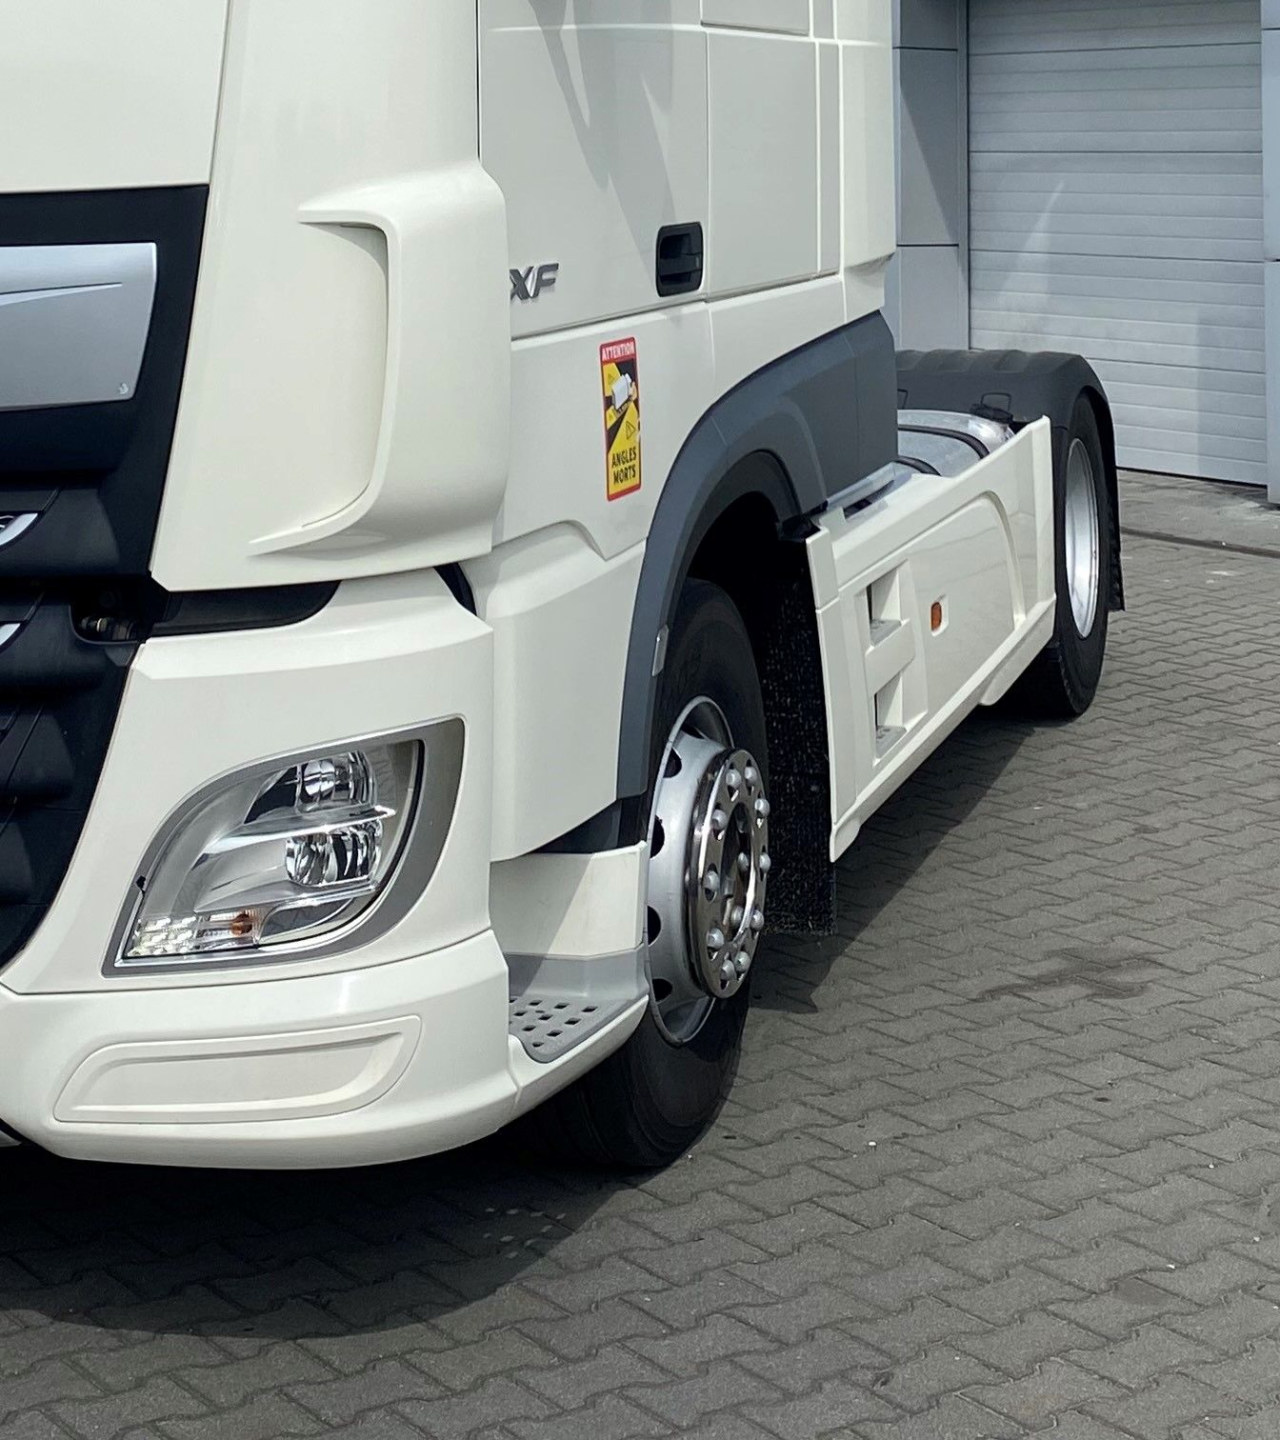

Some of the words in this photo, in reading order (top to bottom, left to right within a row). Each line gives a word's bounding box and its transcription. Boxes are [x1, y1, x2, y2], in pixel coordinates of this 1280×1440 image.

[509, 262, 559, 301] XF
[602, 340, 635, 361] ATTENTION
[611, 446, 637, 468] ANGLES
[613, 464, 637, 486] MORTS
